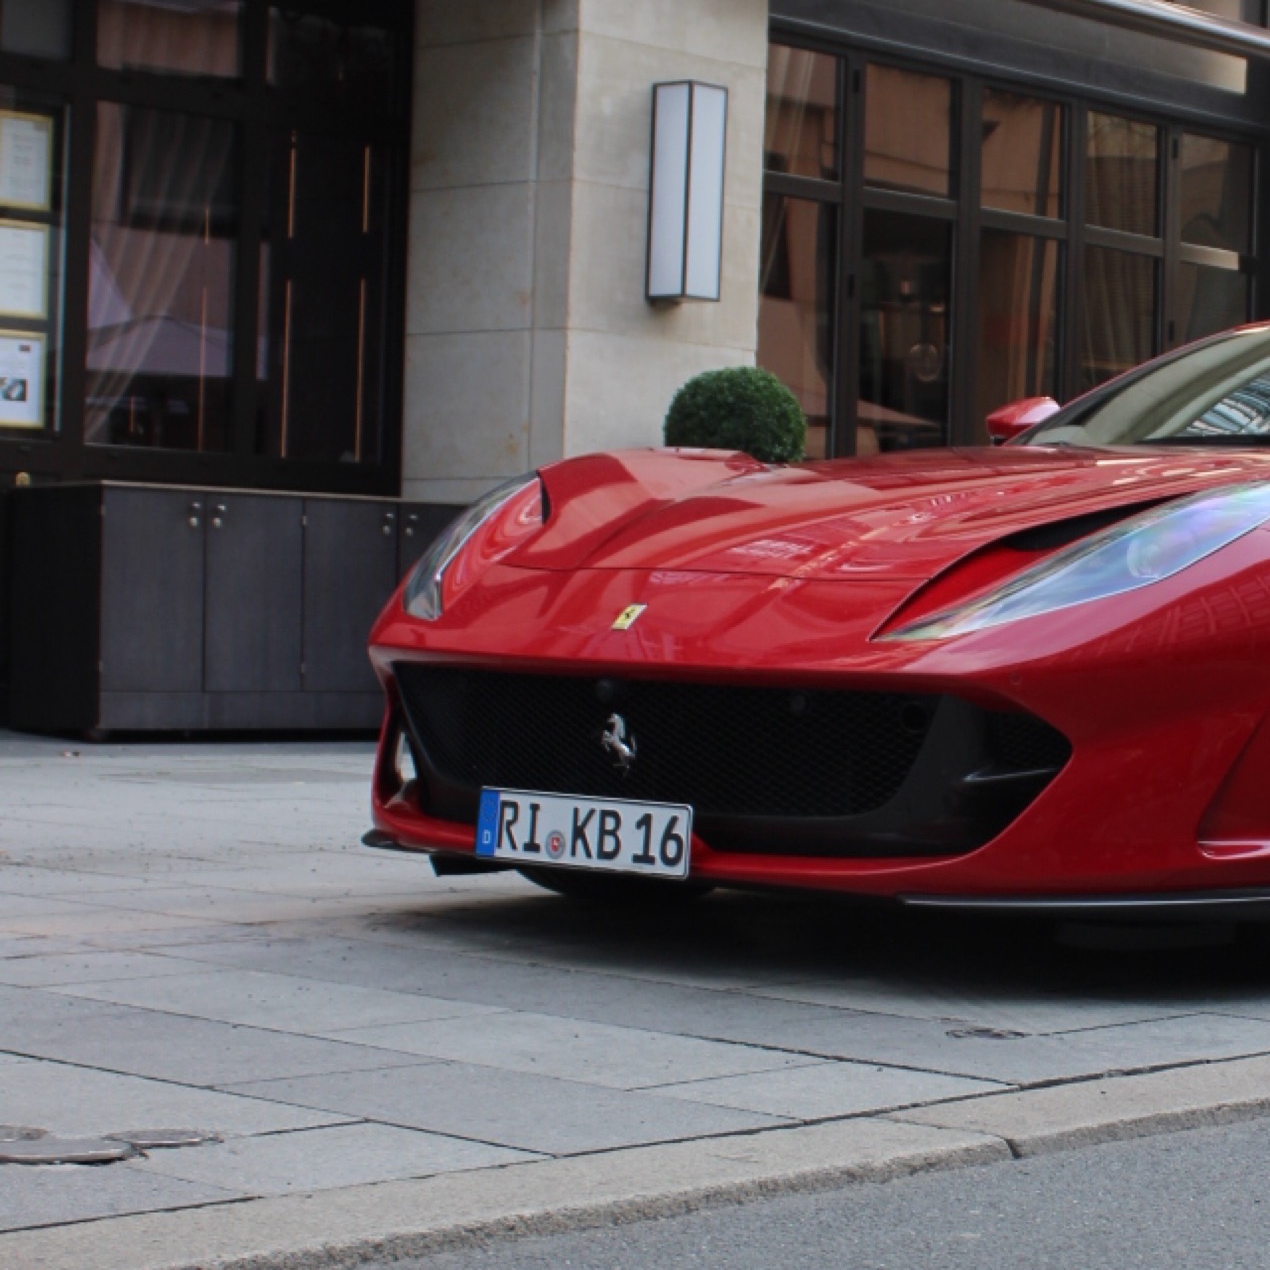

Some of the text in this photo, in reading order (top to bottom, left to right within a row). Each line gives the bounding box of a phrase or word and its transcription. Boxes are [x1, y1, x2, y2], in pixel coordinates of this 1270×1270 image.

[496, 799, 684, 867] RI KB 16
